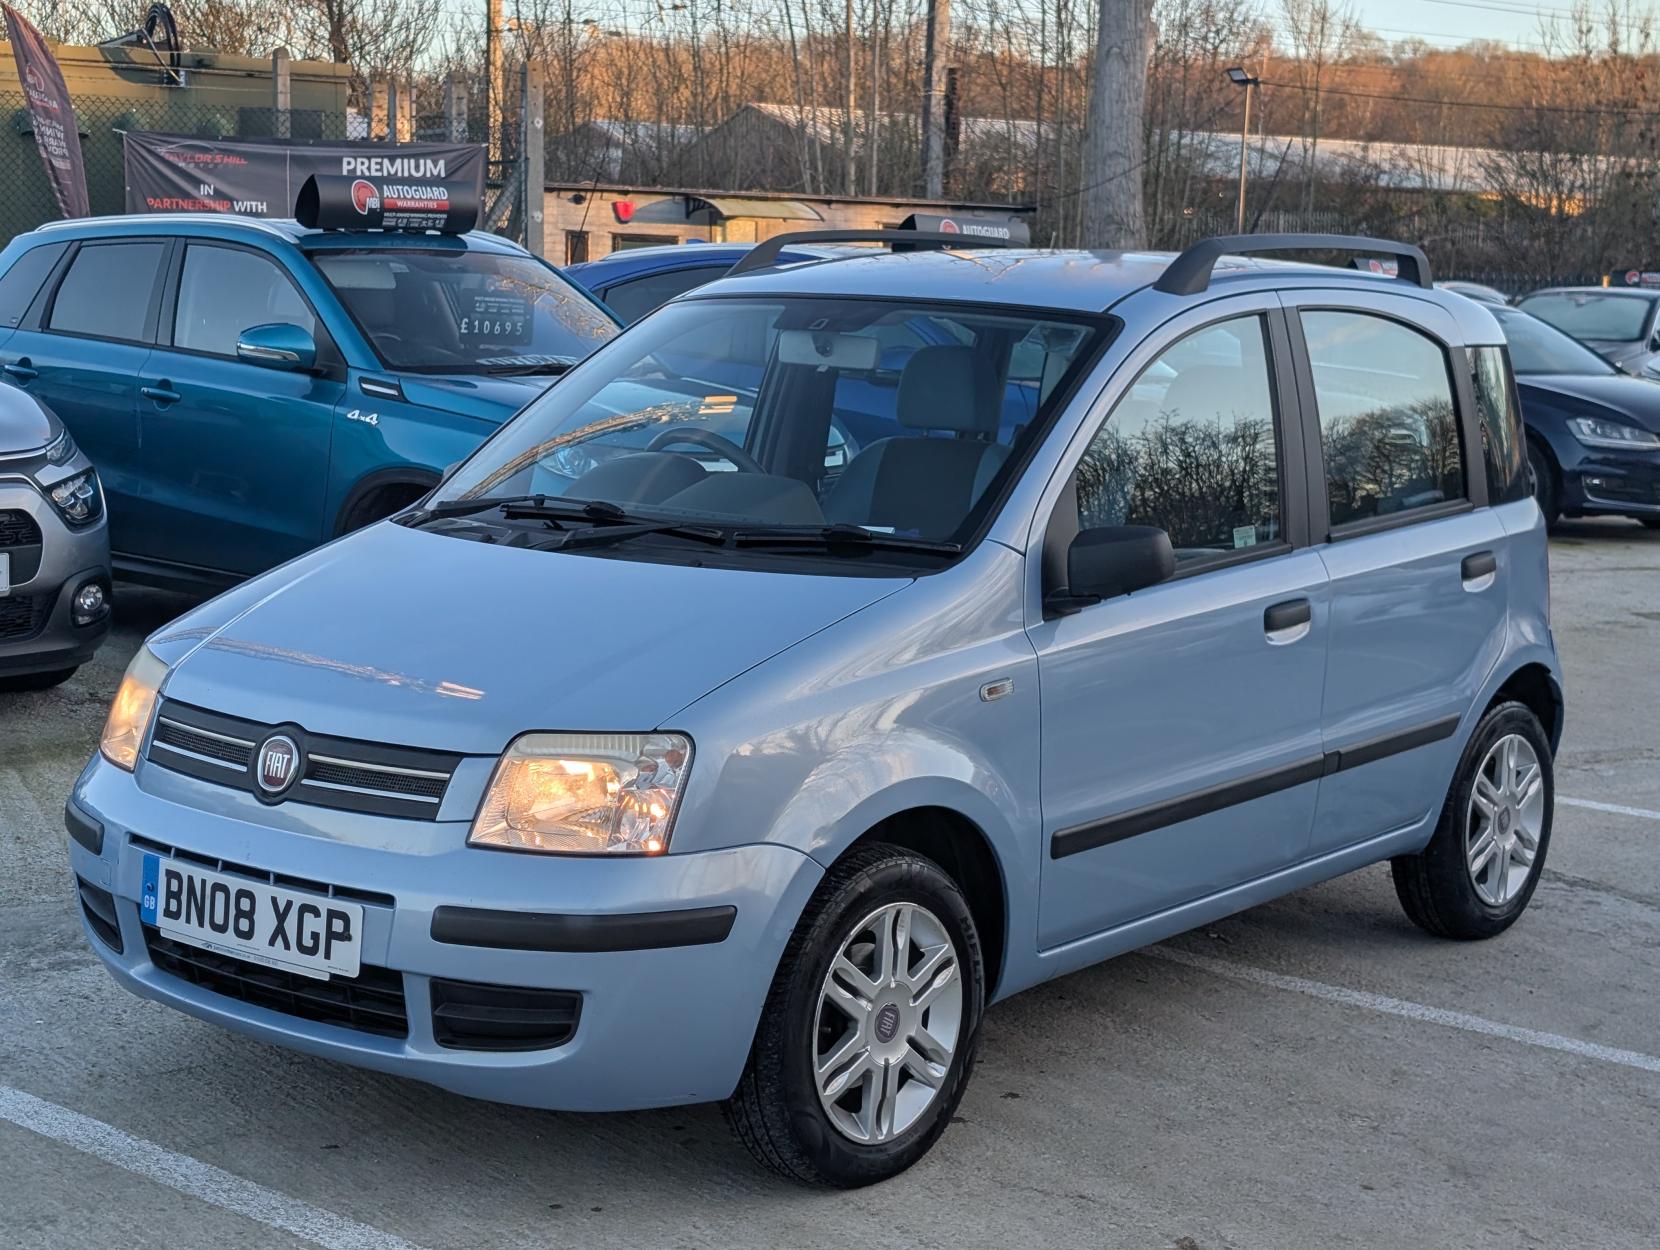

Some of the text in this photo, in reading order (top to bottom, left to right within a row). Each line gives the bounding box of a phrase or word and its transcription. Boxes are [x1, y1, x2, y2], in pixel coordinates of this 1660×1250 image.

[342, 157, 446, 178] PREMIUM
[200, 184, 214, 196] IN
[383, 184, 448, 200] AUTOGUARD
[147, 197, 267, 213] PARTNERSHIP WITH
[397, 200, 438, 209] WARRANTIES
[264, 751, 291, 779] FIAT
[143, 894, 156, 910] GB
[163, 868, 353, 961] BN08 XGP
[879, 1011, 895, 1036] FIAT
